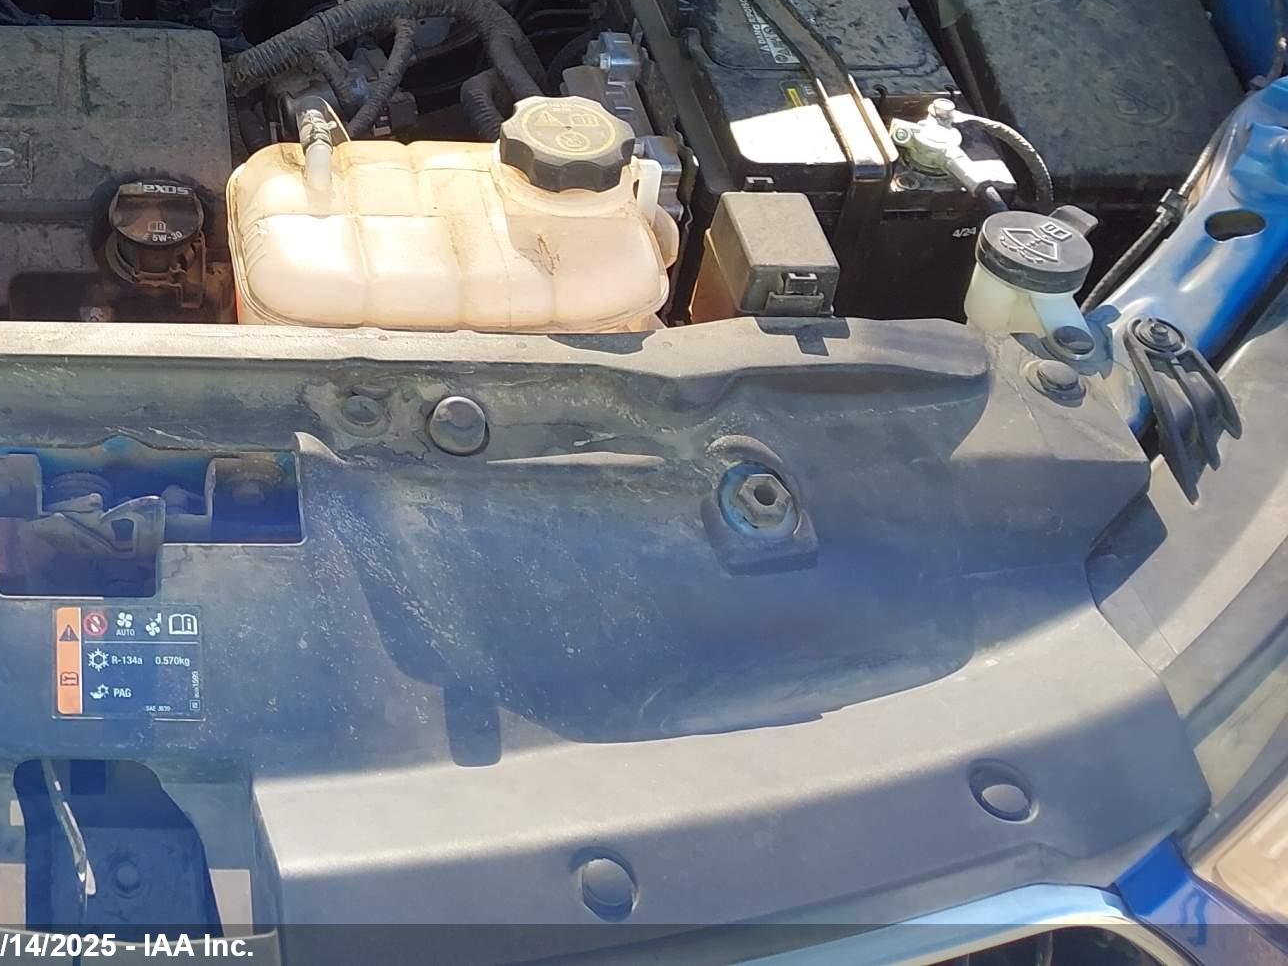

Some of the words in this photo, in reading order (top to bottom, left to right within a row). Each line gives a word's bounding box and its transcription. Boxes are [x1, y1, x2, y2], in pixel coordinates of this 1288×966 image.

[152, 231, 183, 243] 5W-30
[116, 629, 135, 637] AUTO
[111, 656, 143, 665] R-134a
[155, 656, 190, 667] 0.570kg
[113, 688, 132, 698] PAG
